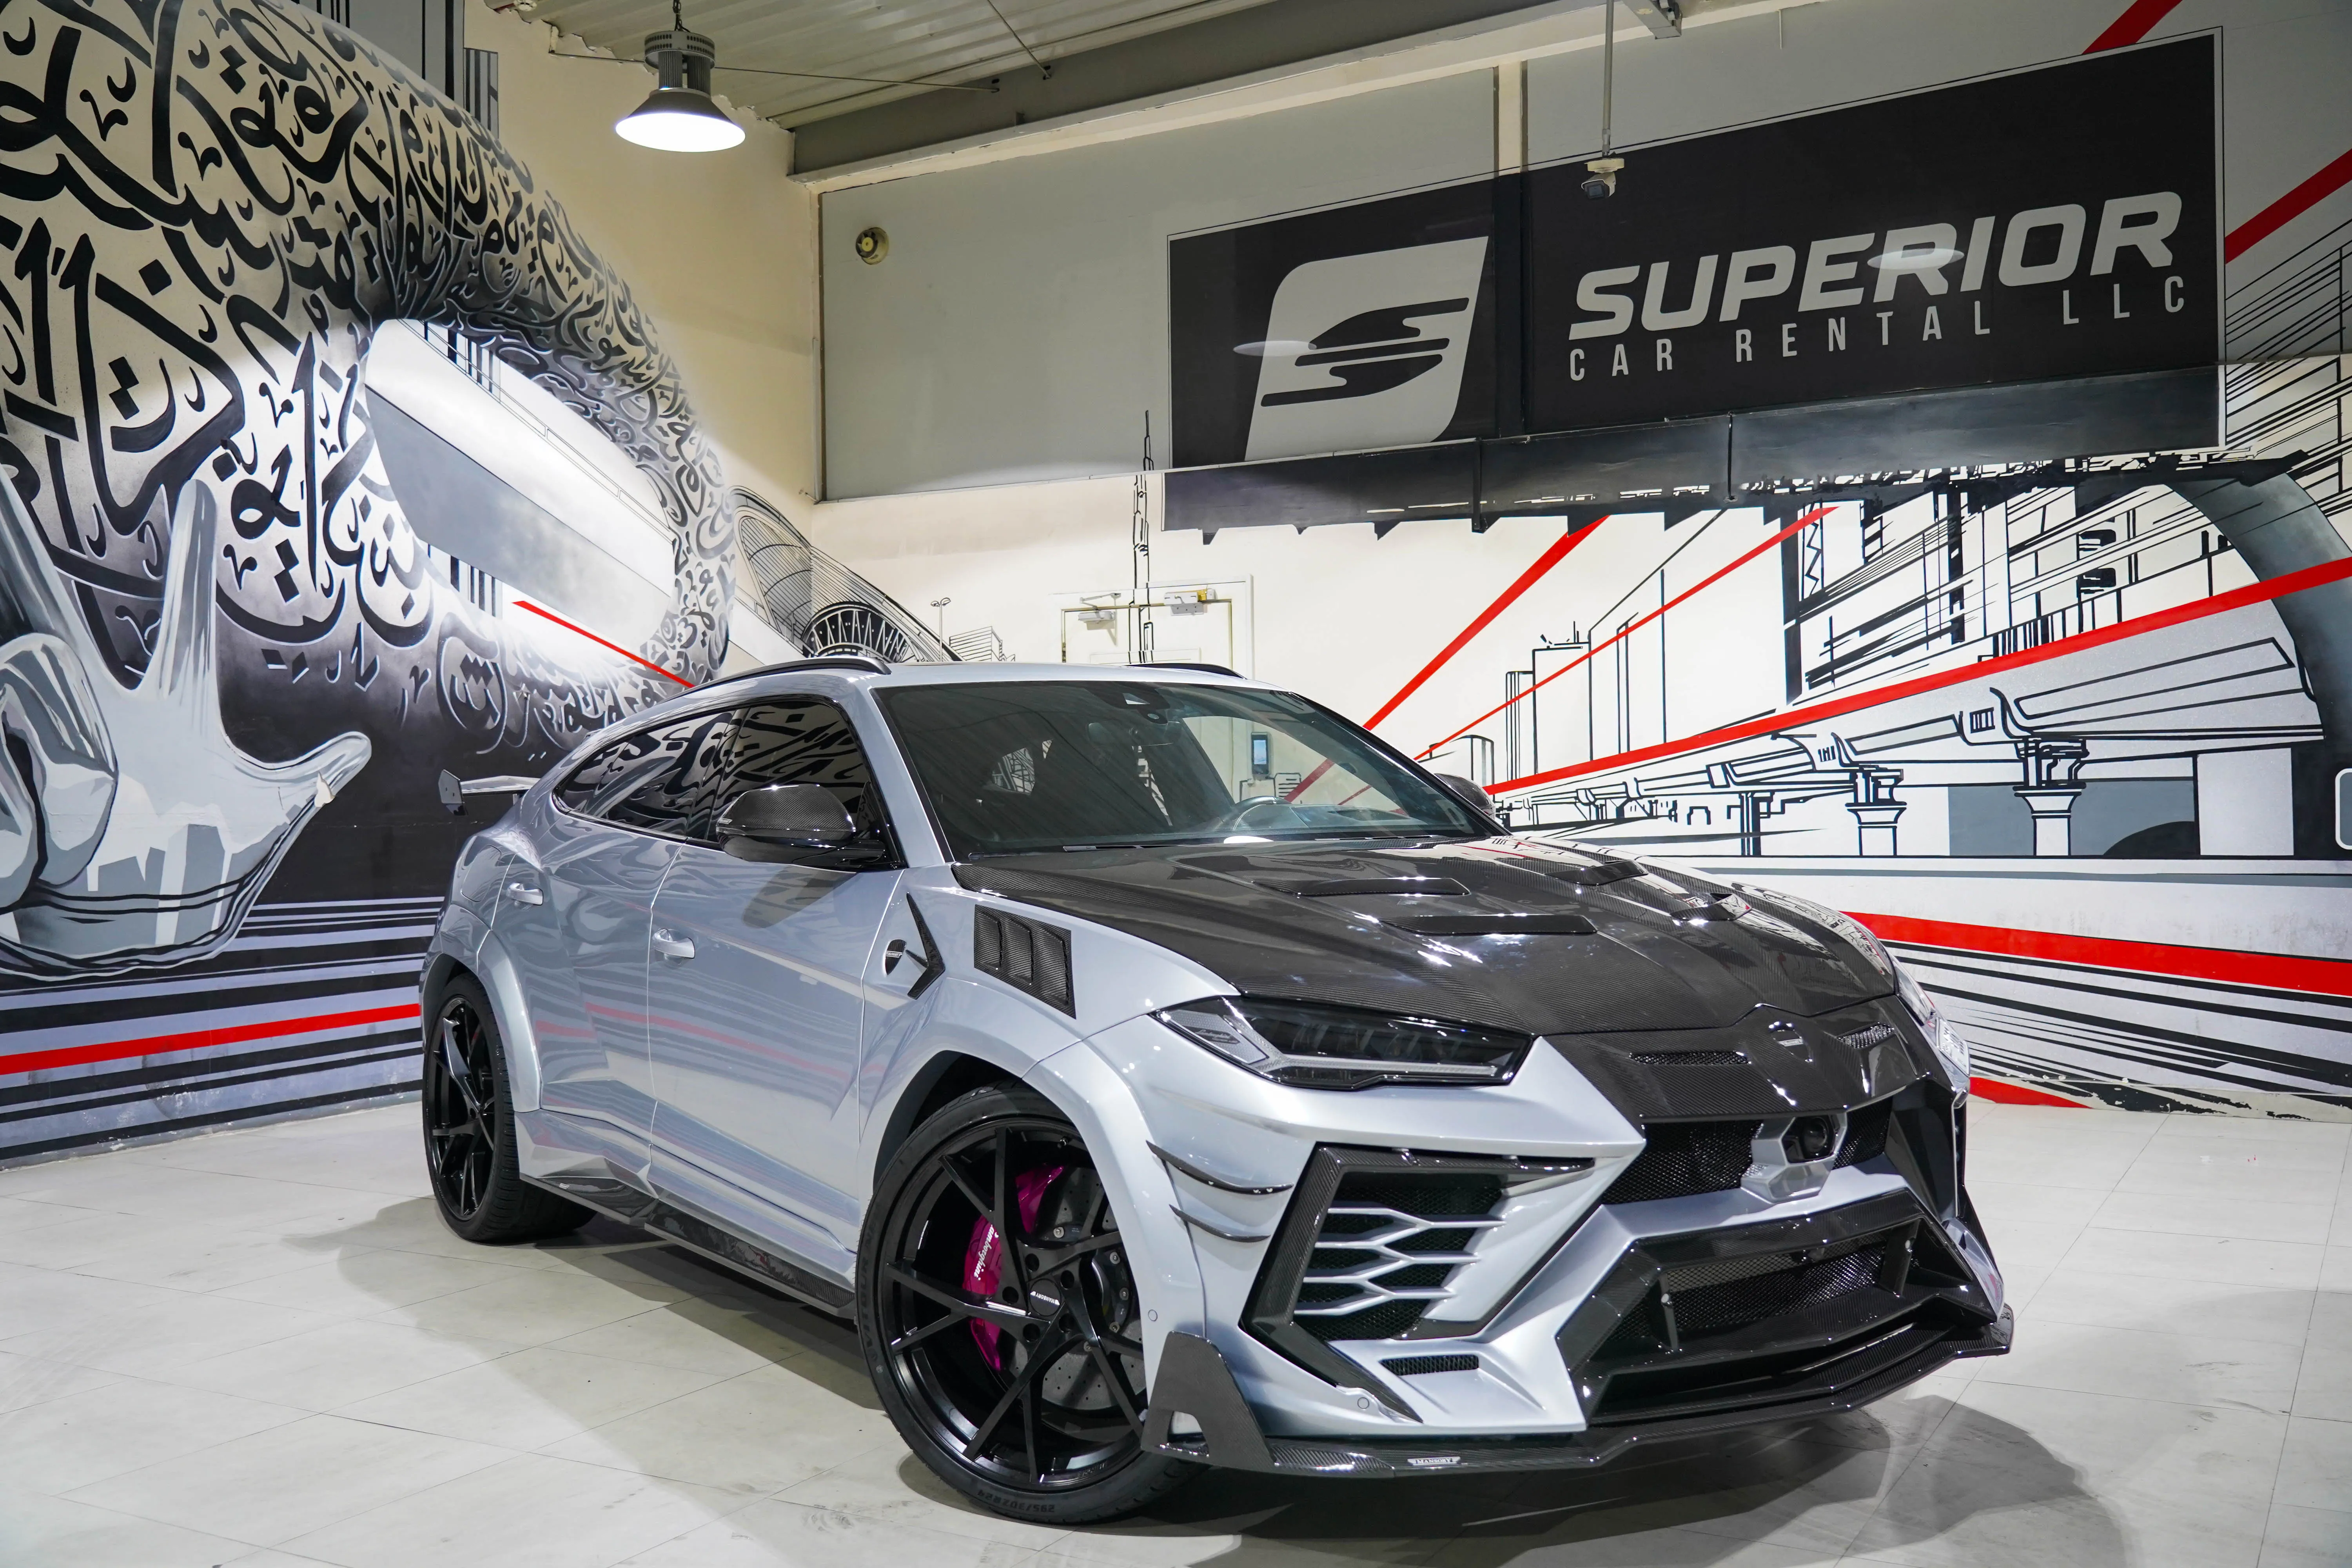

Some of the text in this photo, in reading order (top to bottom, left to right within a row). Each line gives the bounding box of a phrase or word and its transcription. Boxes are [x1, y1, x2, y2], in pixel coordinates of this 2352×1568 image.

[1569, 192, 2181, 340] SUPERIOR
[1570, 276, 2183, 380] CAR RENTAL LLC
[1036, 1293, 1055, 1303] MANSORY
